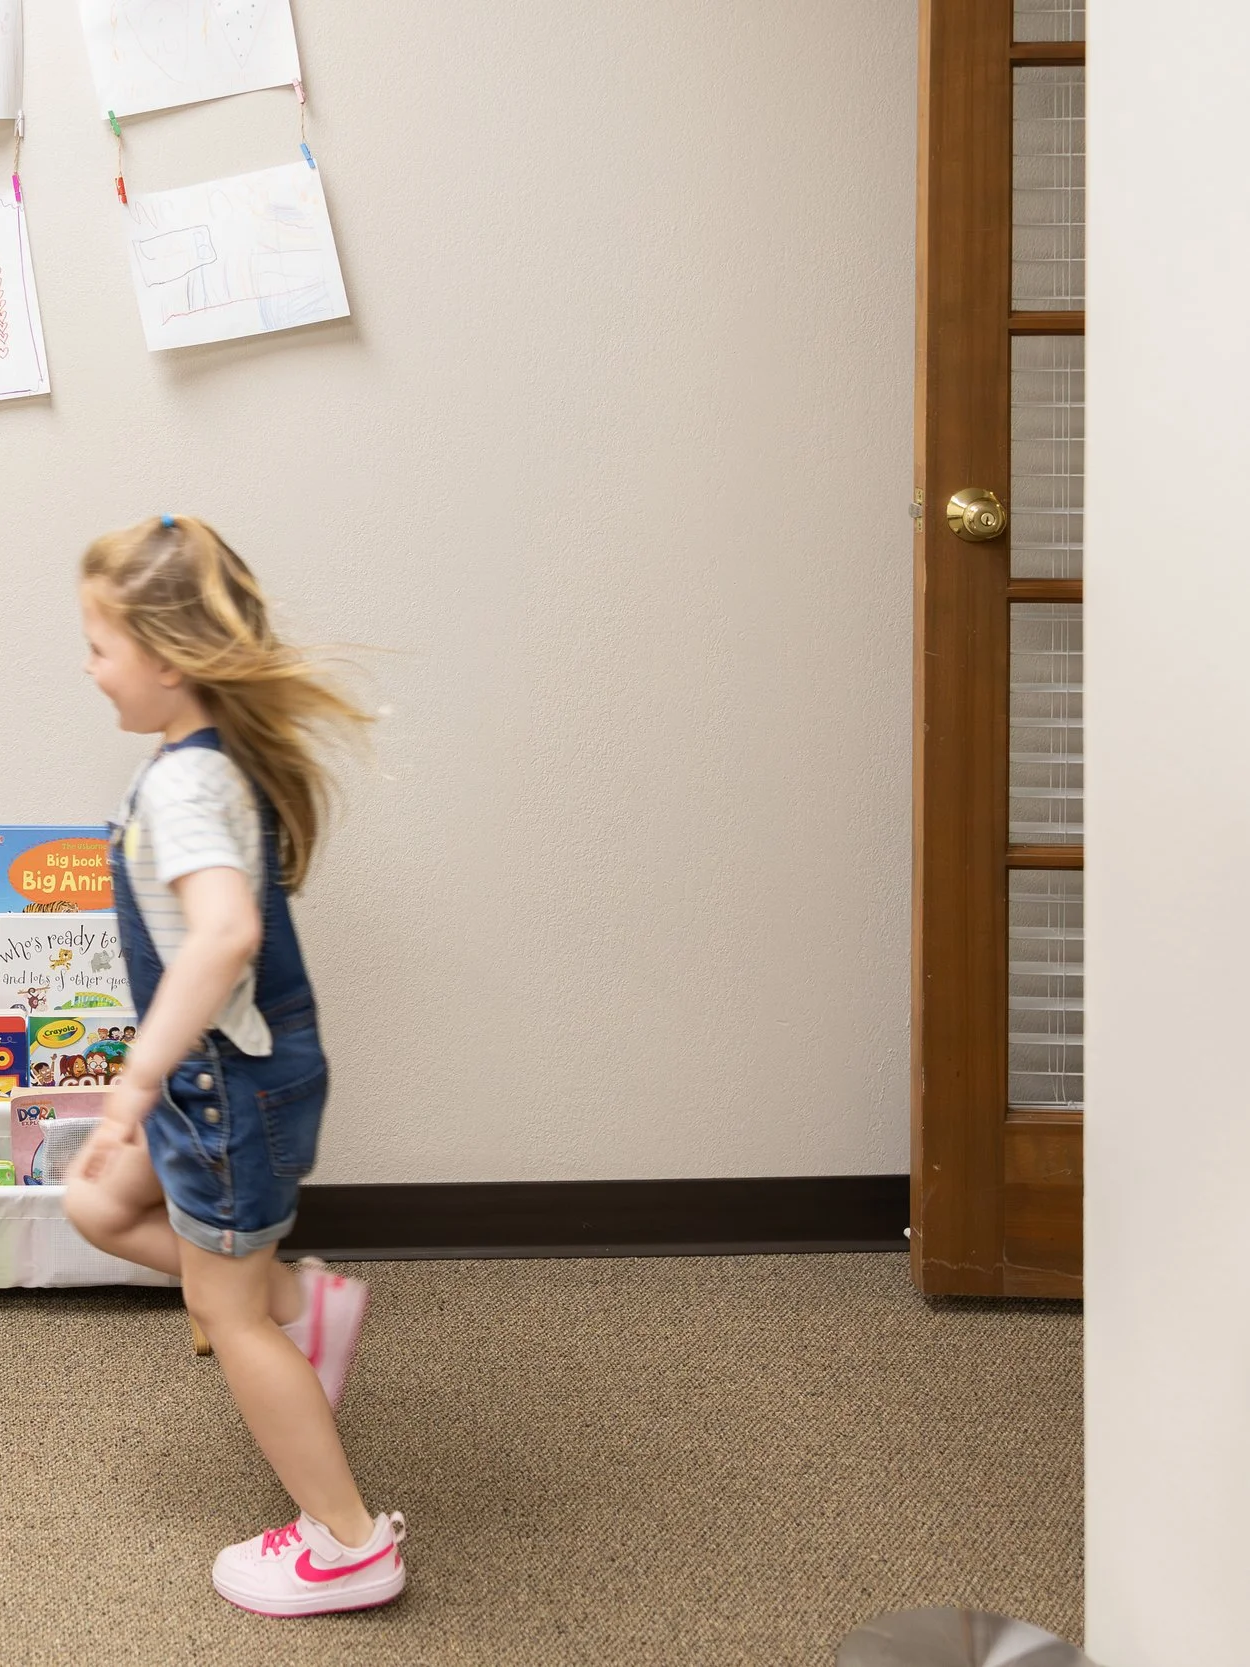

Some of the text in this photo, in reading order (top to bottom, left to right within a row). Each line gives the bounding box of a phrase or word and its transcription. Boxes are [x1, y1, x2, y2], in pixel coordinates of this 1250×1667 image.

[47, 854, 69, 869] Big
[72, 855, 102, 867] book
[22, 870, 56, 893] Big
[0, 936, 43, 963] who's
[47, 924, 95, 955] ready
[100, 931, 117, 949] to
[2, 970, 26, 985] and
[30, 971, 50, 985] lots
[55, 968, 66, 991] of
[70, 971, 103, 989] other
[44, 1025, 76, 1037] Crayola
[16, 1105, 57, 1122] DORA
